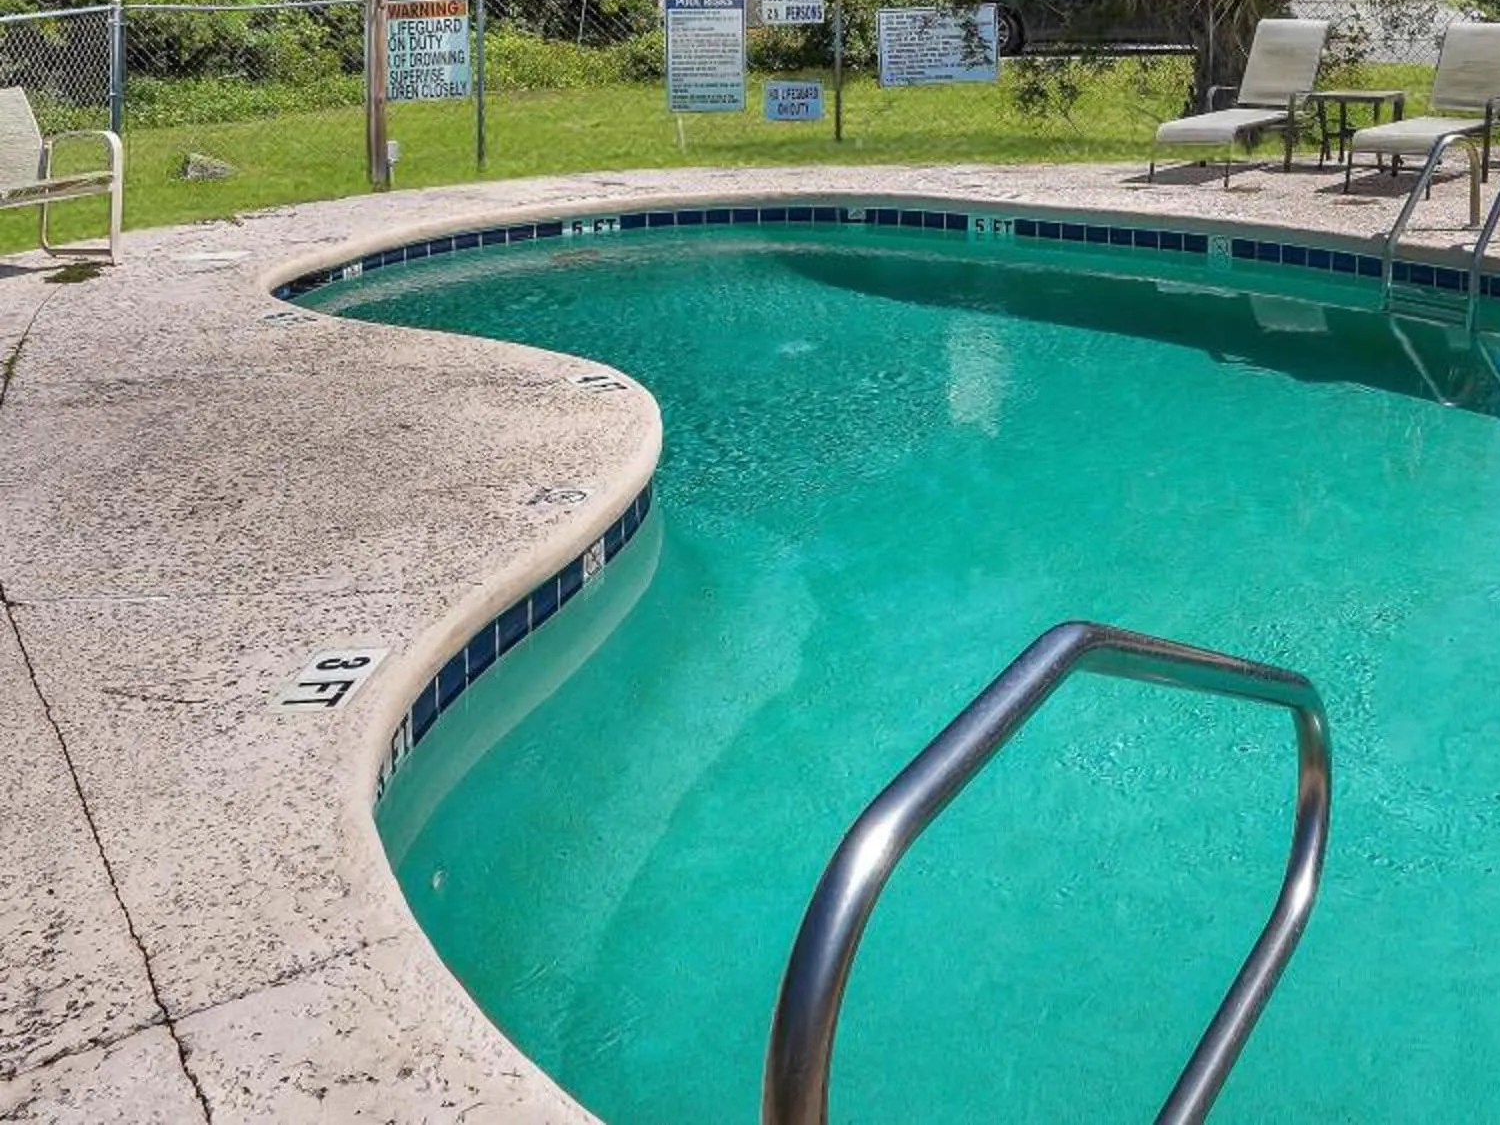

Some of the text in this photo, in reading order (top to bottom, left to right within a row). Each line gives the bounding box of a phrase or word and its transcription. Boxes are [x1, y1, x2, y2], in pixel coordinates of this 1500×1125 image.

[386, 0, 459, 18] WARNING
[785, 4, 823, 20] PERSONS
[390, 19, 462, 36] LIFEGUARD
[388, 35, 443, 52] ON DUTY
[393, 54, 407, 68] OF
[409, 49, 465, 68] DROWNING
[390, 67, 445, 86] SUPERVISE
[421, 81, 468, 97] CLOSELY
[281, 656, 371, 708] 3 FT
